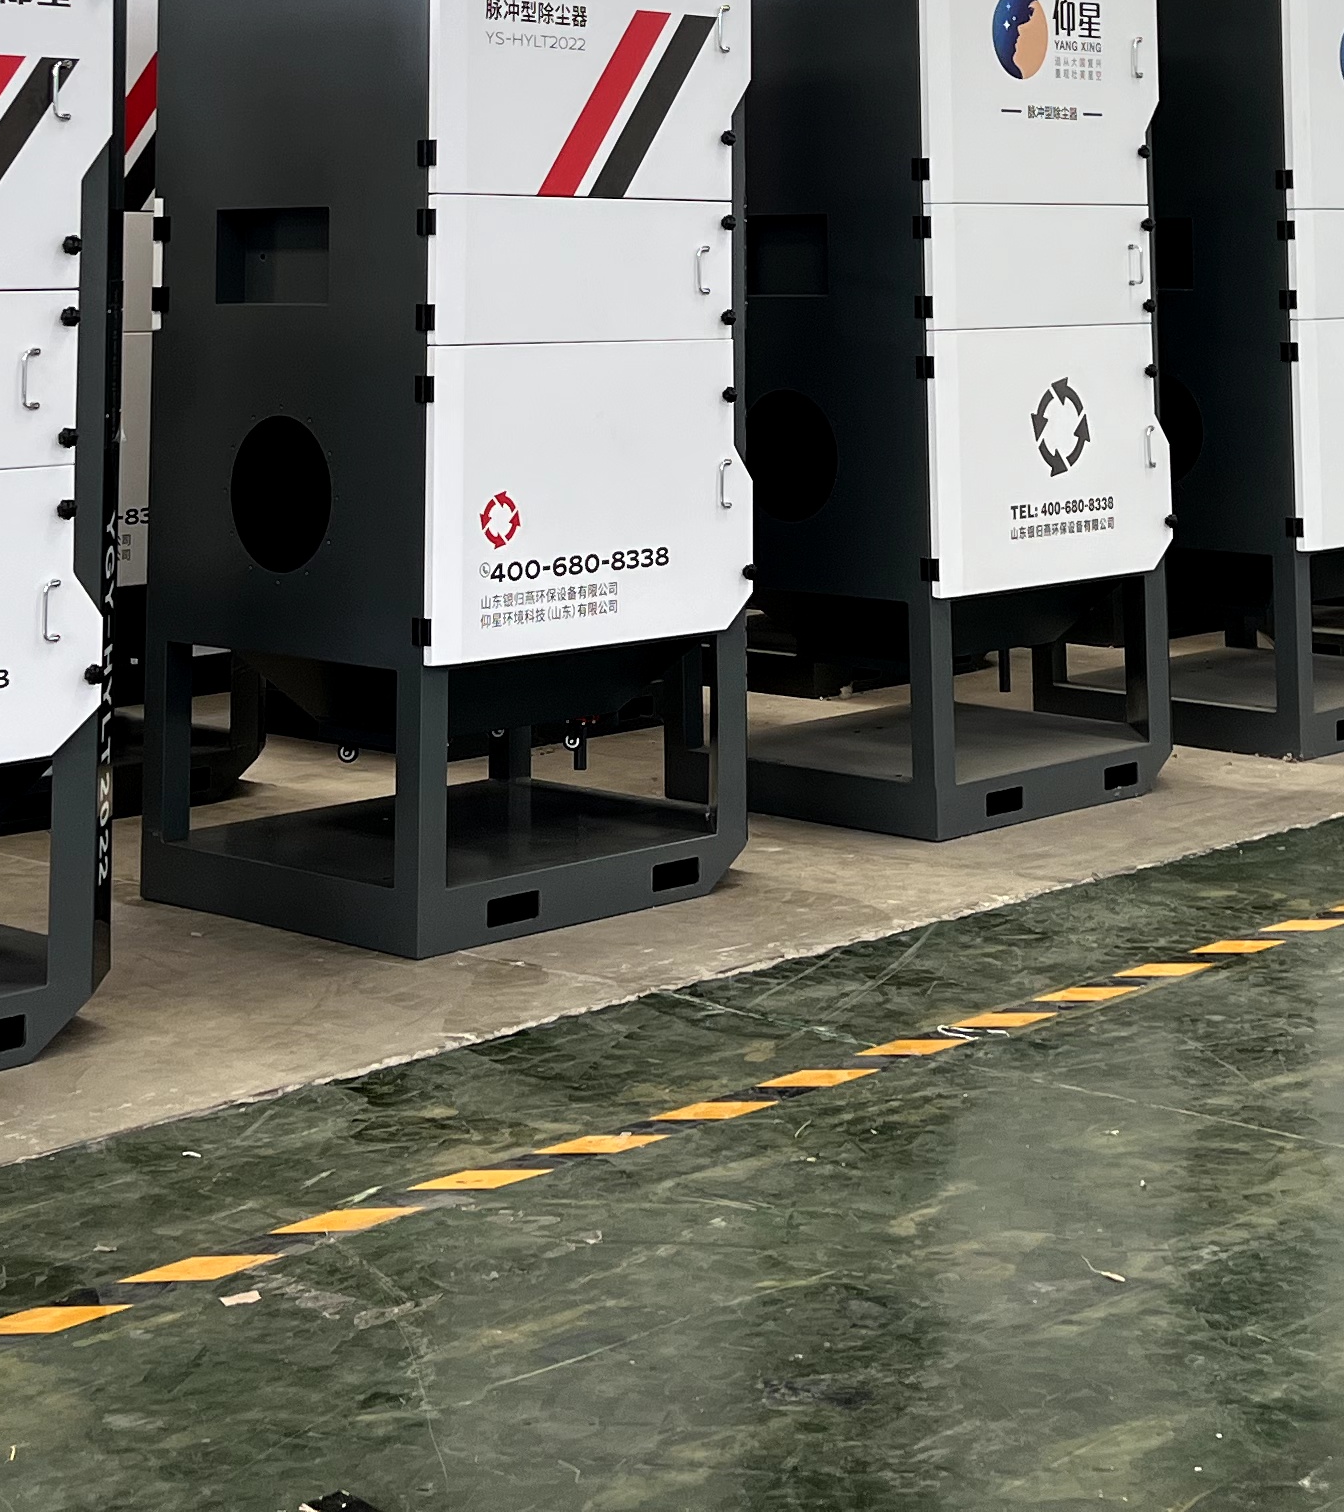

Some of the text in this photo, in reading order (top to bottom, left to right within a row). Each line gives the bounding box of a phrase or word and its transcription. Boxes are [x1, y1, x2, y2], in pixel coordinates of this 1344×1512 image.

[485, 31, 586, 51] YS-HYLT2022
[1054, 40, 1102, 53] YANG XING
[1011, 496, 1114, 520] TEL: 400-680-8338
[490, 546, 670, 582] 400-680-8338
[480, 581, 618, 610] 山东银归燕环保设备有限公司
